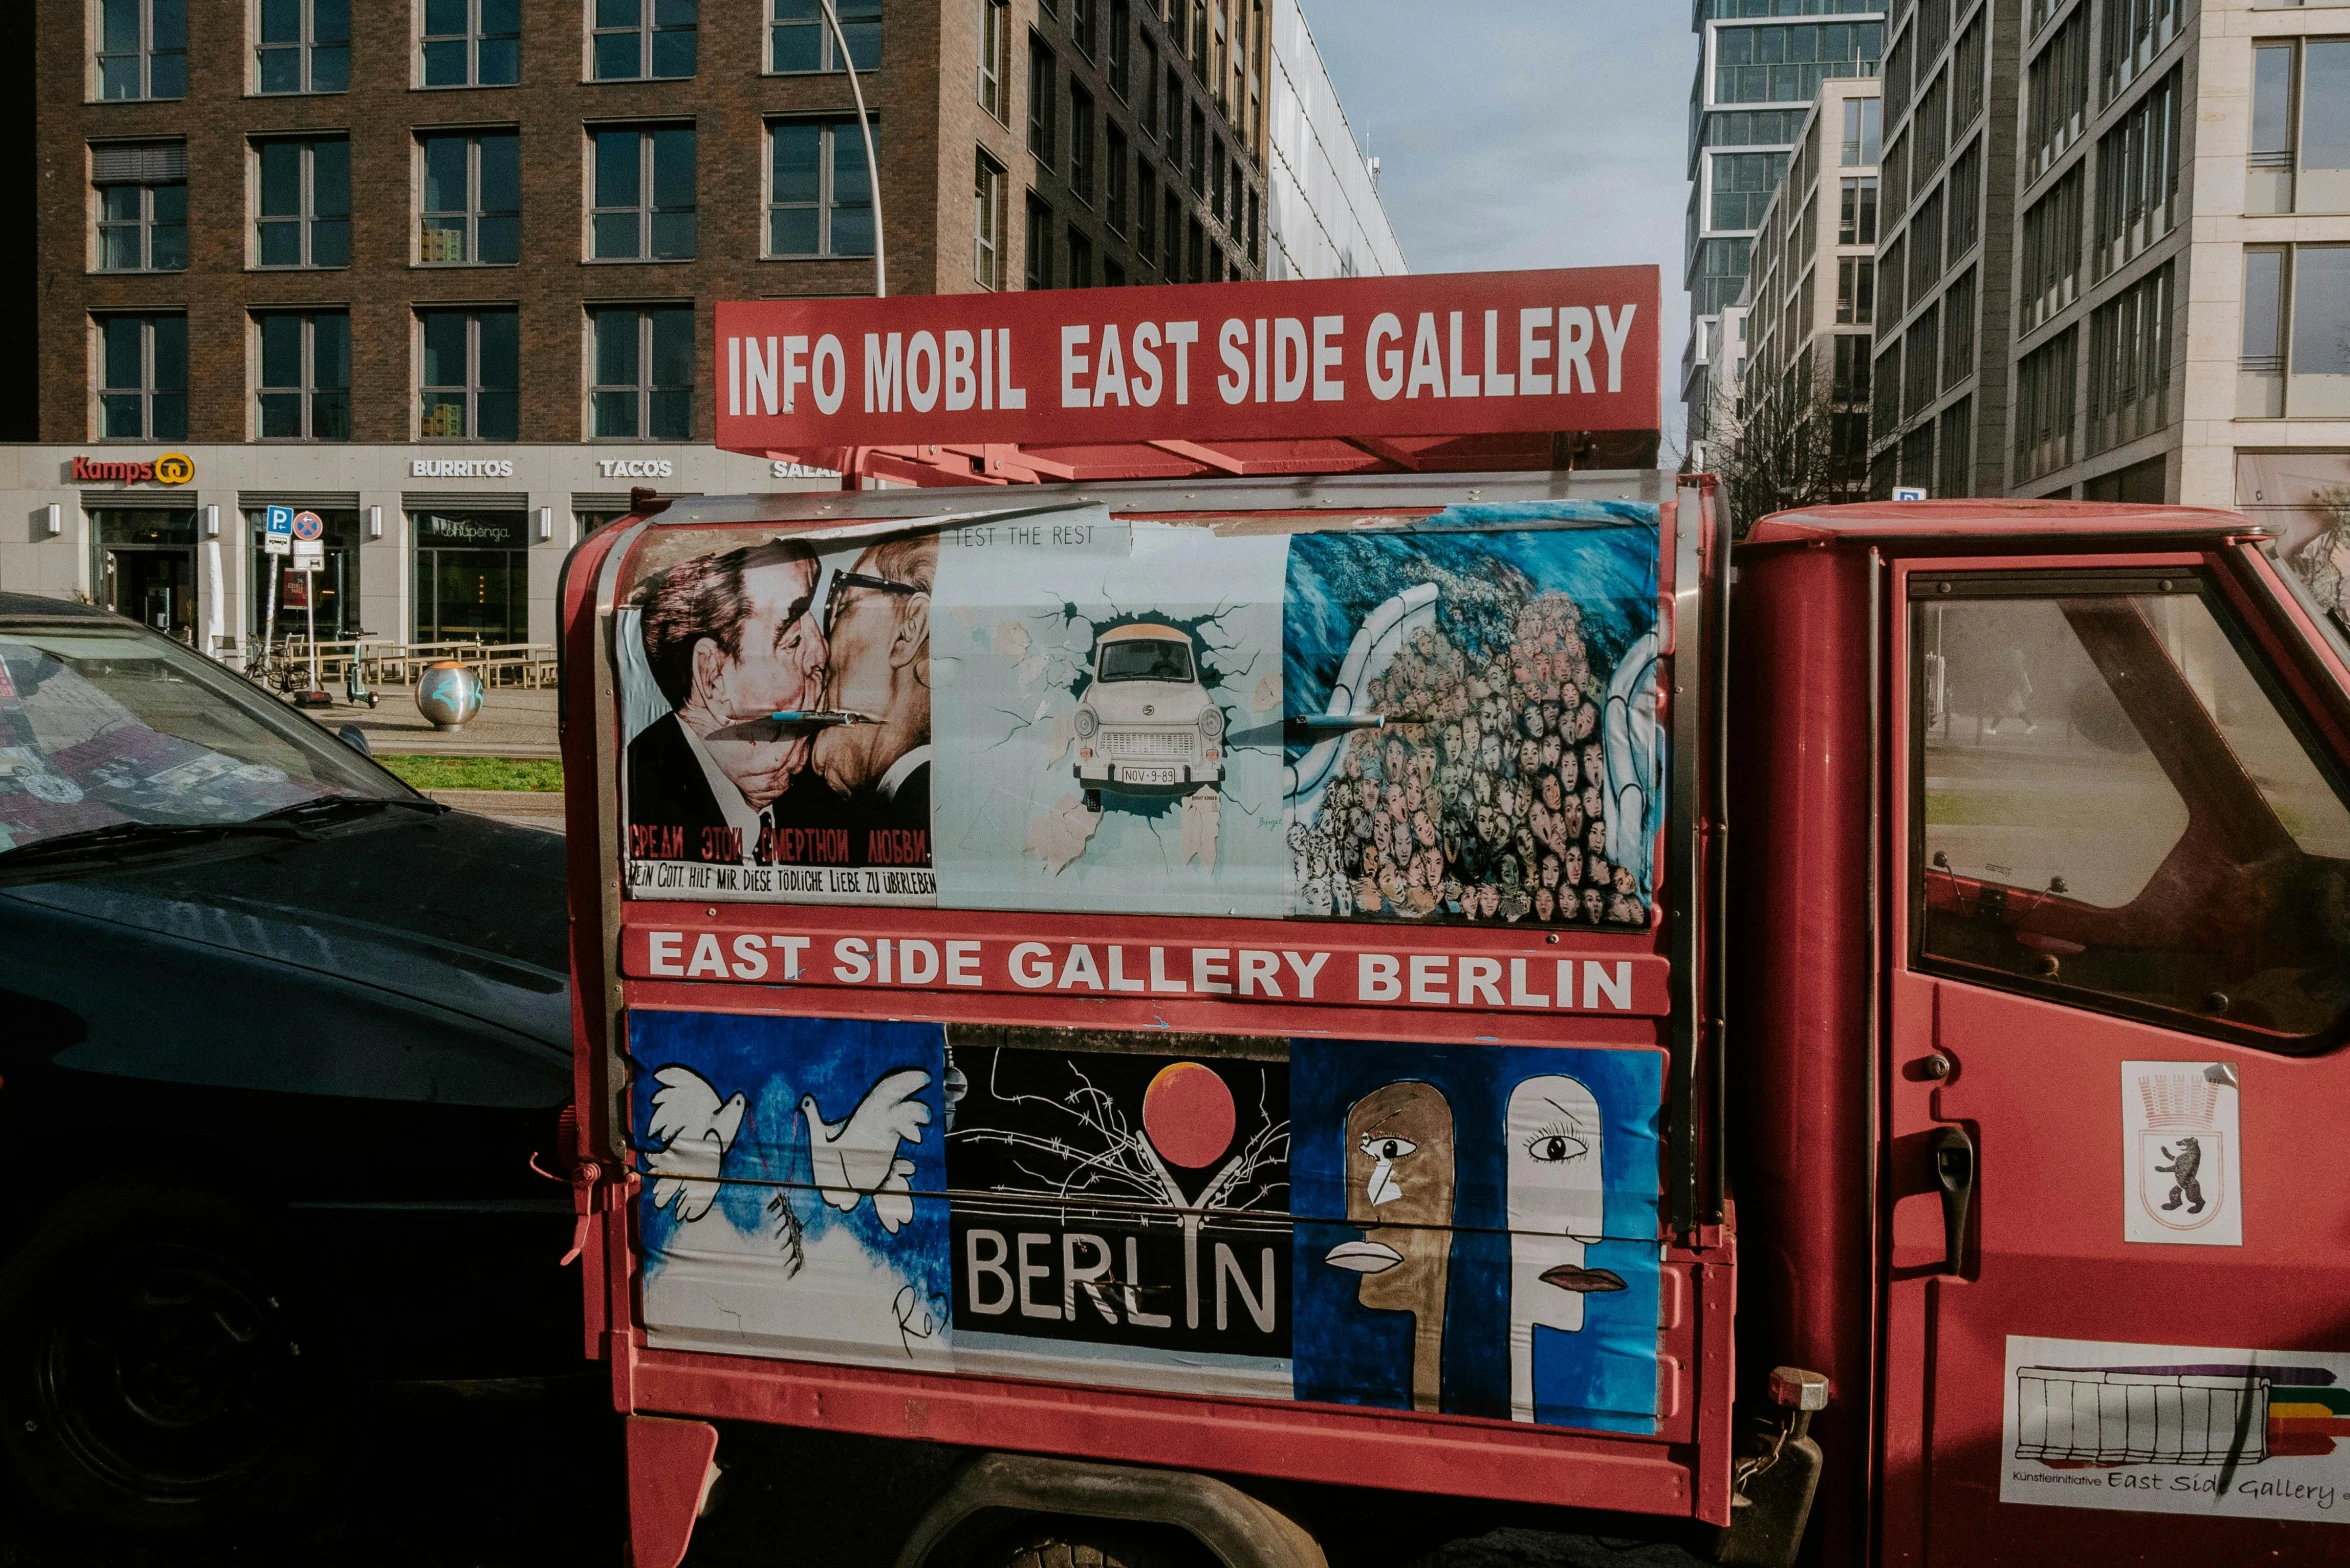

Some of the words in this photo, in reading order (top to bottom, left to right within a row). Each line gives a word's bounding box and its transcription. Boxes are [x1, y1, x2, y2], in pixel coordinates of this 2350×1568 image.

[728, 334, 846, 416] INFO
[865, 329, 1027, 413] MOBIL
[1062, 321, 1199, 408] EAST
[1218, 316, 1345, 405] SIDE
[1366, 304, 1638, 401] GALLERY
[73, 456, 154, 485] Kamps
[413, 460, 513, 477] BURRITOS
[600, 460, 673, 477] TACOS
[273, 510, 287, 530] P
[952, 527, 996, 547] TEST
[1007, 527, 1041, 546] THE
[1053, 525, 1095, 545] REST
[866, 871, 880, 894] ZU
[650, 932, 811, 981] EAST
[833, 938, 983, 987] SIDE
[1009, 942, 1331, 999] GALLERY
[1359, 954, 1632, 1010] BERLIN
[966, 1228, 1275, 1334] BERLIN
[2013, 1471, 2102, 1486] Künstlerinitiative
[2108, 1472, 2163, 1490] East
[2170, 1473, 2228, 1496] Side
[2238, 1479, 2334, 1510] Gallery
